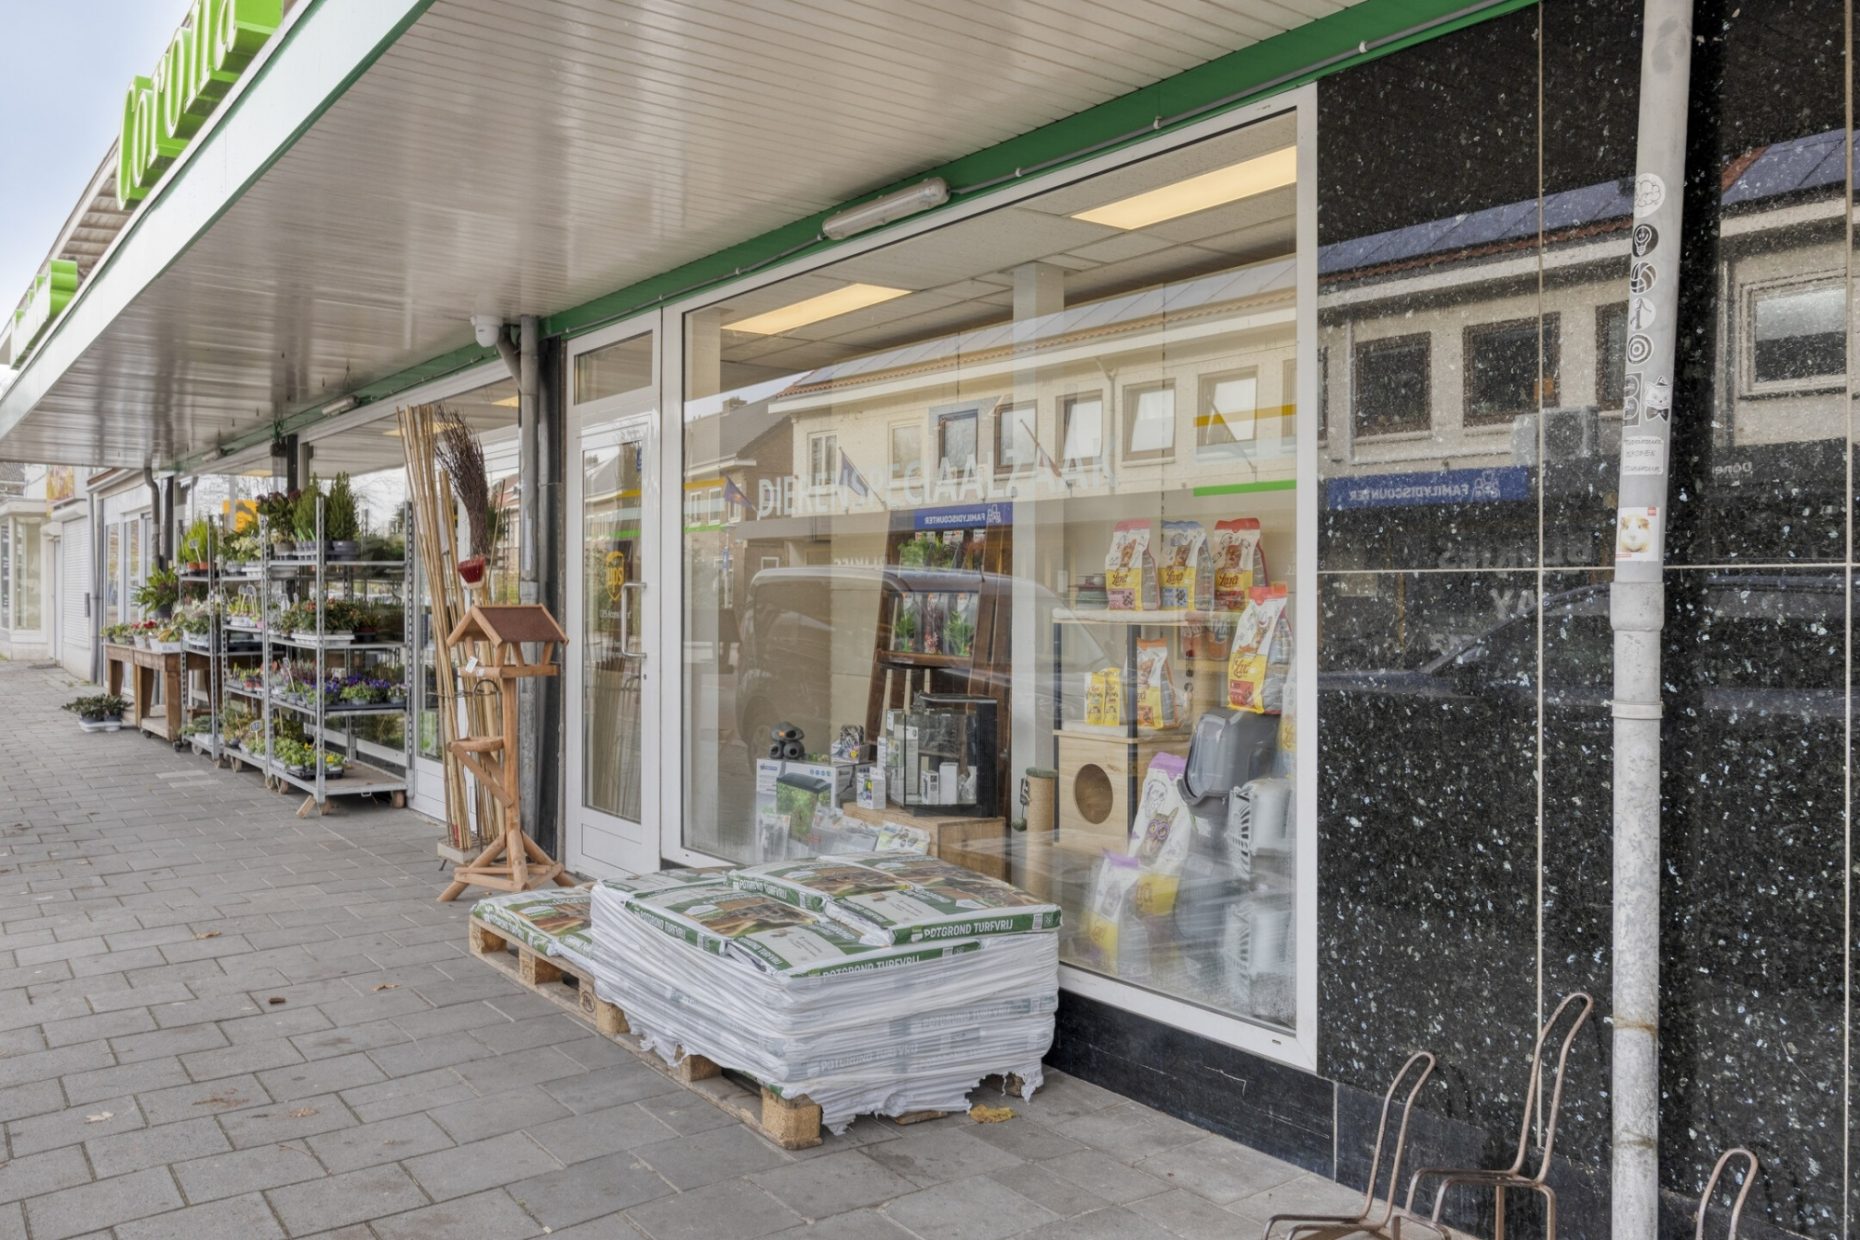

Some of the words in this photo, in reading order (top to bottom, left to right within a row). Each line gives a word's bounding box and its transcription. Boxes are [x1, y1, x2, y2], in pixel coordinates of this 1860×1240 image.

[606, 567, 625, 593] ups
[923, 923, 973, 939] POTGROND
[974, 919, 1014, 933] TURFVRIJ
[876, 954, 921, 971] TURFVRIJ
